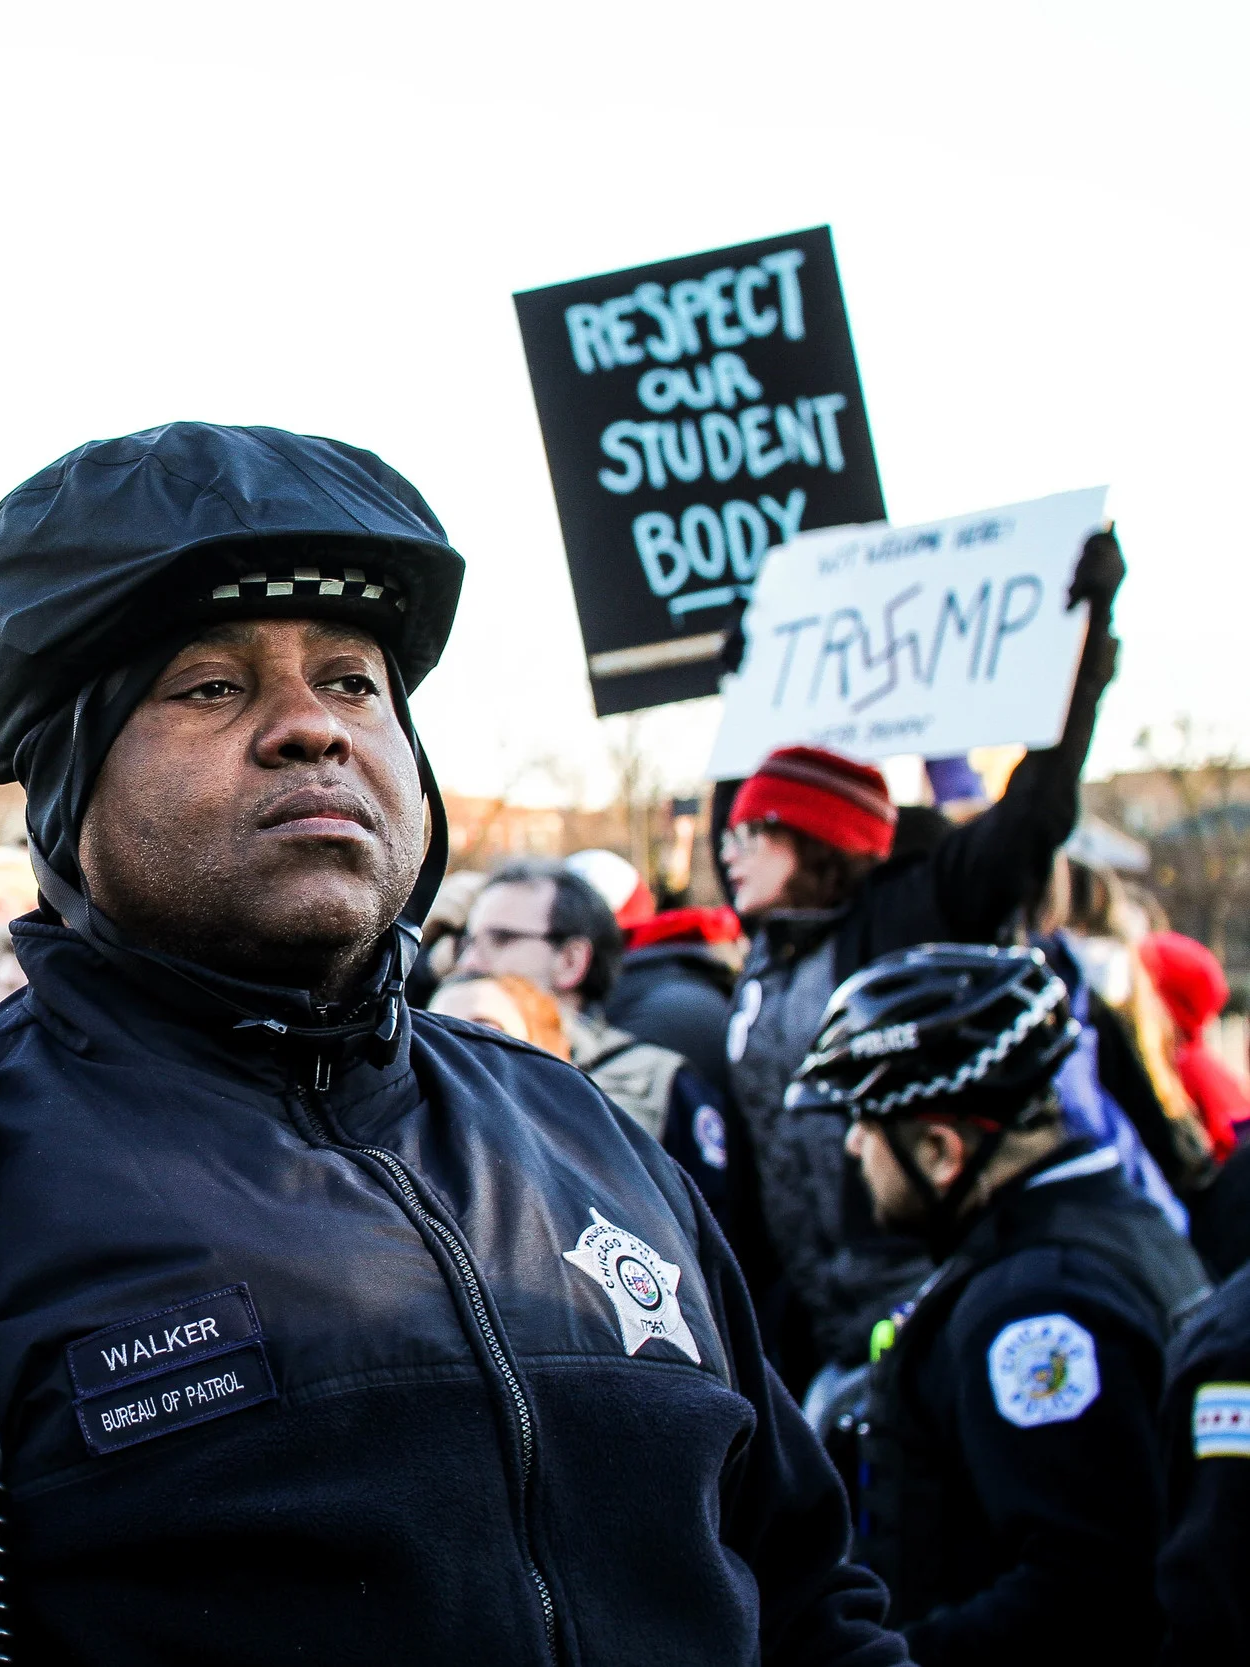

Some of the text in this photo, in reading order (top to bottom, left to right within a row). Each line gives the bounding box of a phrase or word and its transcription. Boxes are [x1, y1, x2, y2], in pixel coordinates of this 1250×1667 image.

[563, 248, 807, 374] RESPECT
[638, 351, 763, 412] OUR
[598, 394, 848, 494] STUDENT
[631, 488, 807, 597] BODY
[598, 1238, 622, 1289] CHICAGO
[100, 1317, 220, 1372] WALKER
[101, 1371, 245, 1432] BUREAU OF PATROL
